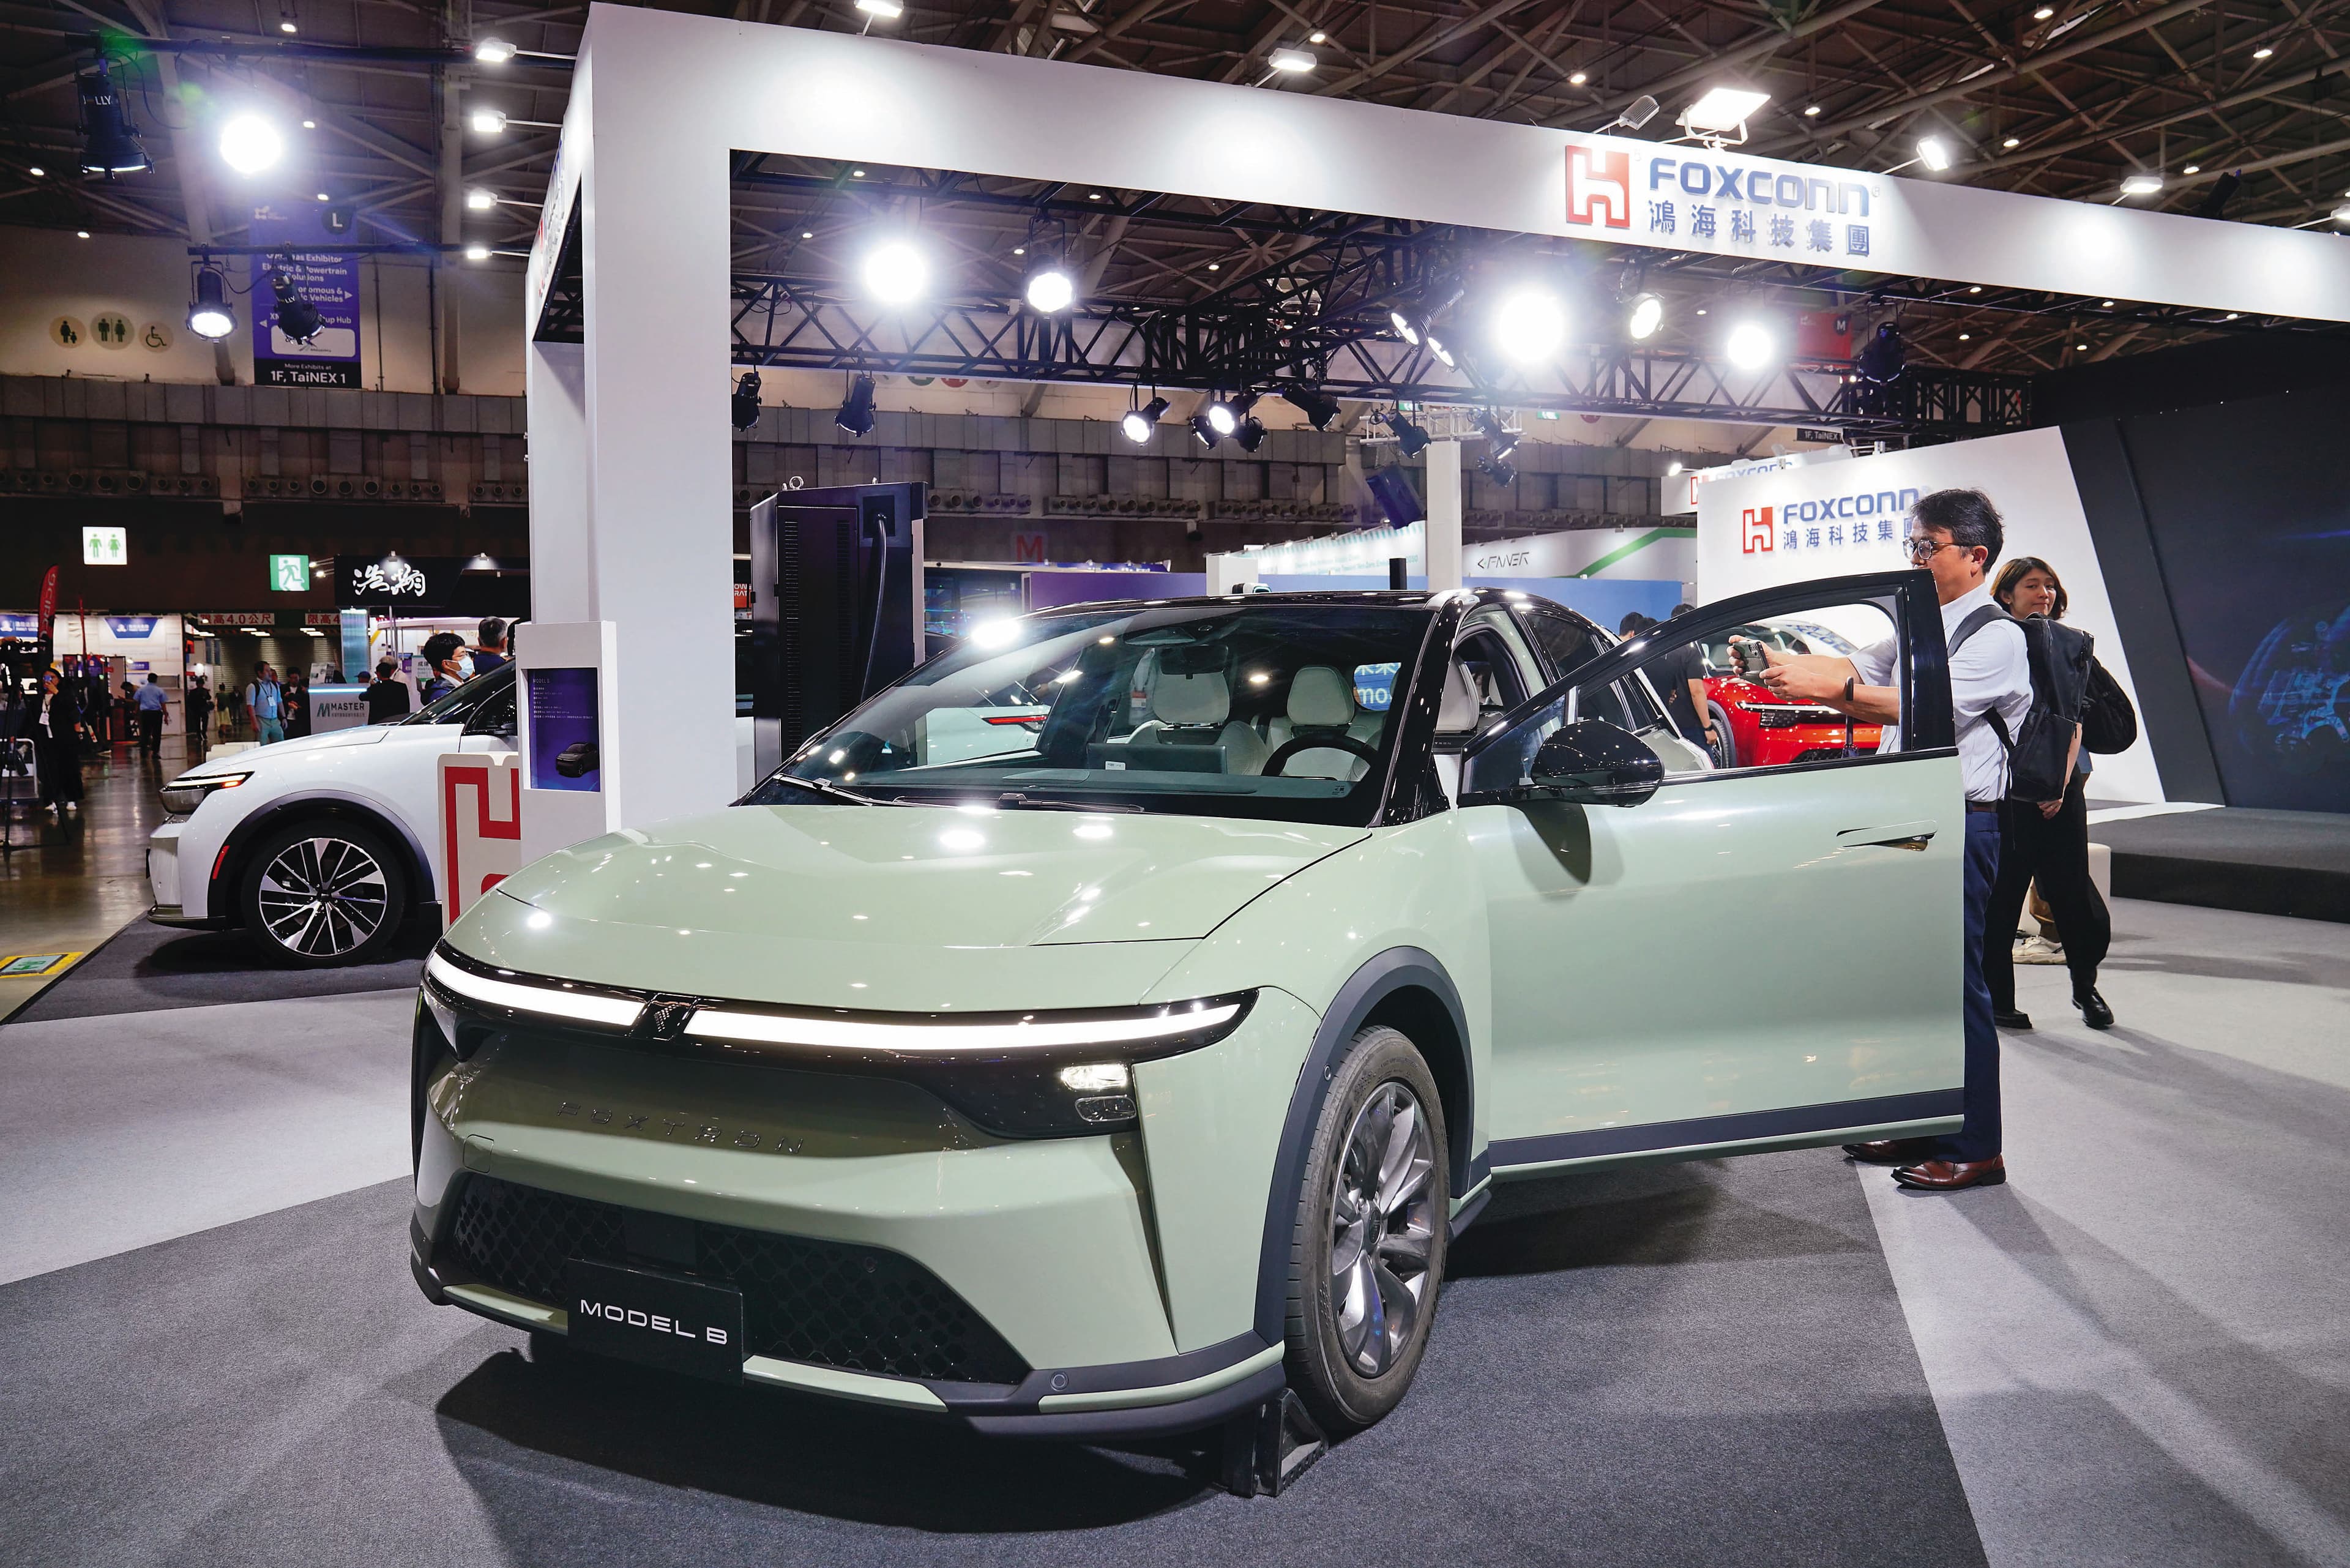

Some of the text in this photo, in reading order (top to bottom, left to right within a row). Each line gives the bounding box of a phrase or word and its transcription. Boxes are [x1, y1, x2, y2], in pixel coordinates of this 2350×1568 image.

[332, 213, 343, 227] L
[1647, 199, 1870, 257] 鴻海科技集團
[306, 253, 343, 263] Exhibitor
[263, 263, 294, 272] Eltric
[310, 293, 343, 302] Vehicles
[1837, 320, 1846, 330] M
[270, 371, 346, 383] 1F, TaiNEX 1
[1814, 431, 1838, 441] TaiNEX
[1016, 534, 1043, 562] M
[558, 1102, 804, 1154] FOXTRON
[580, 1299, 728, 1345] MODEL B
